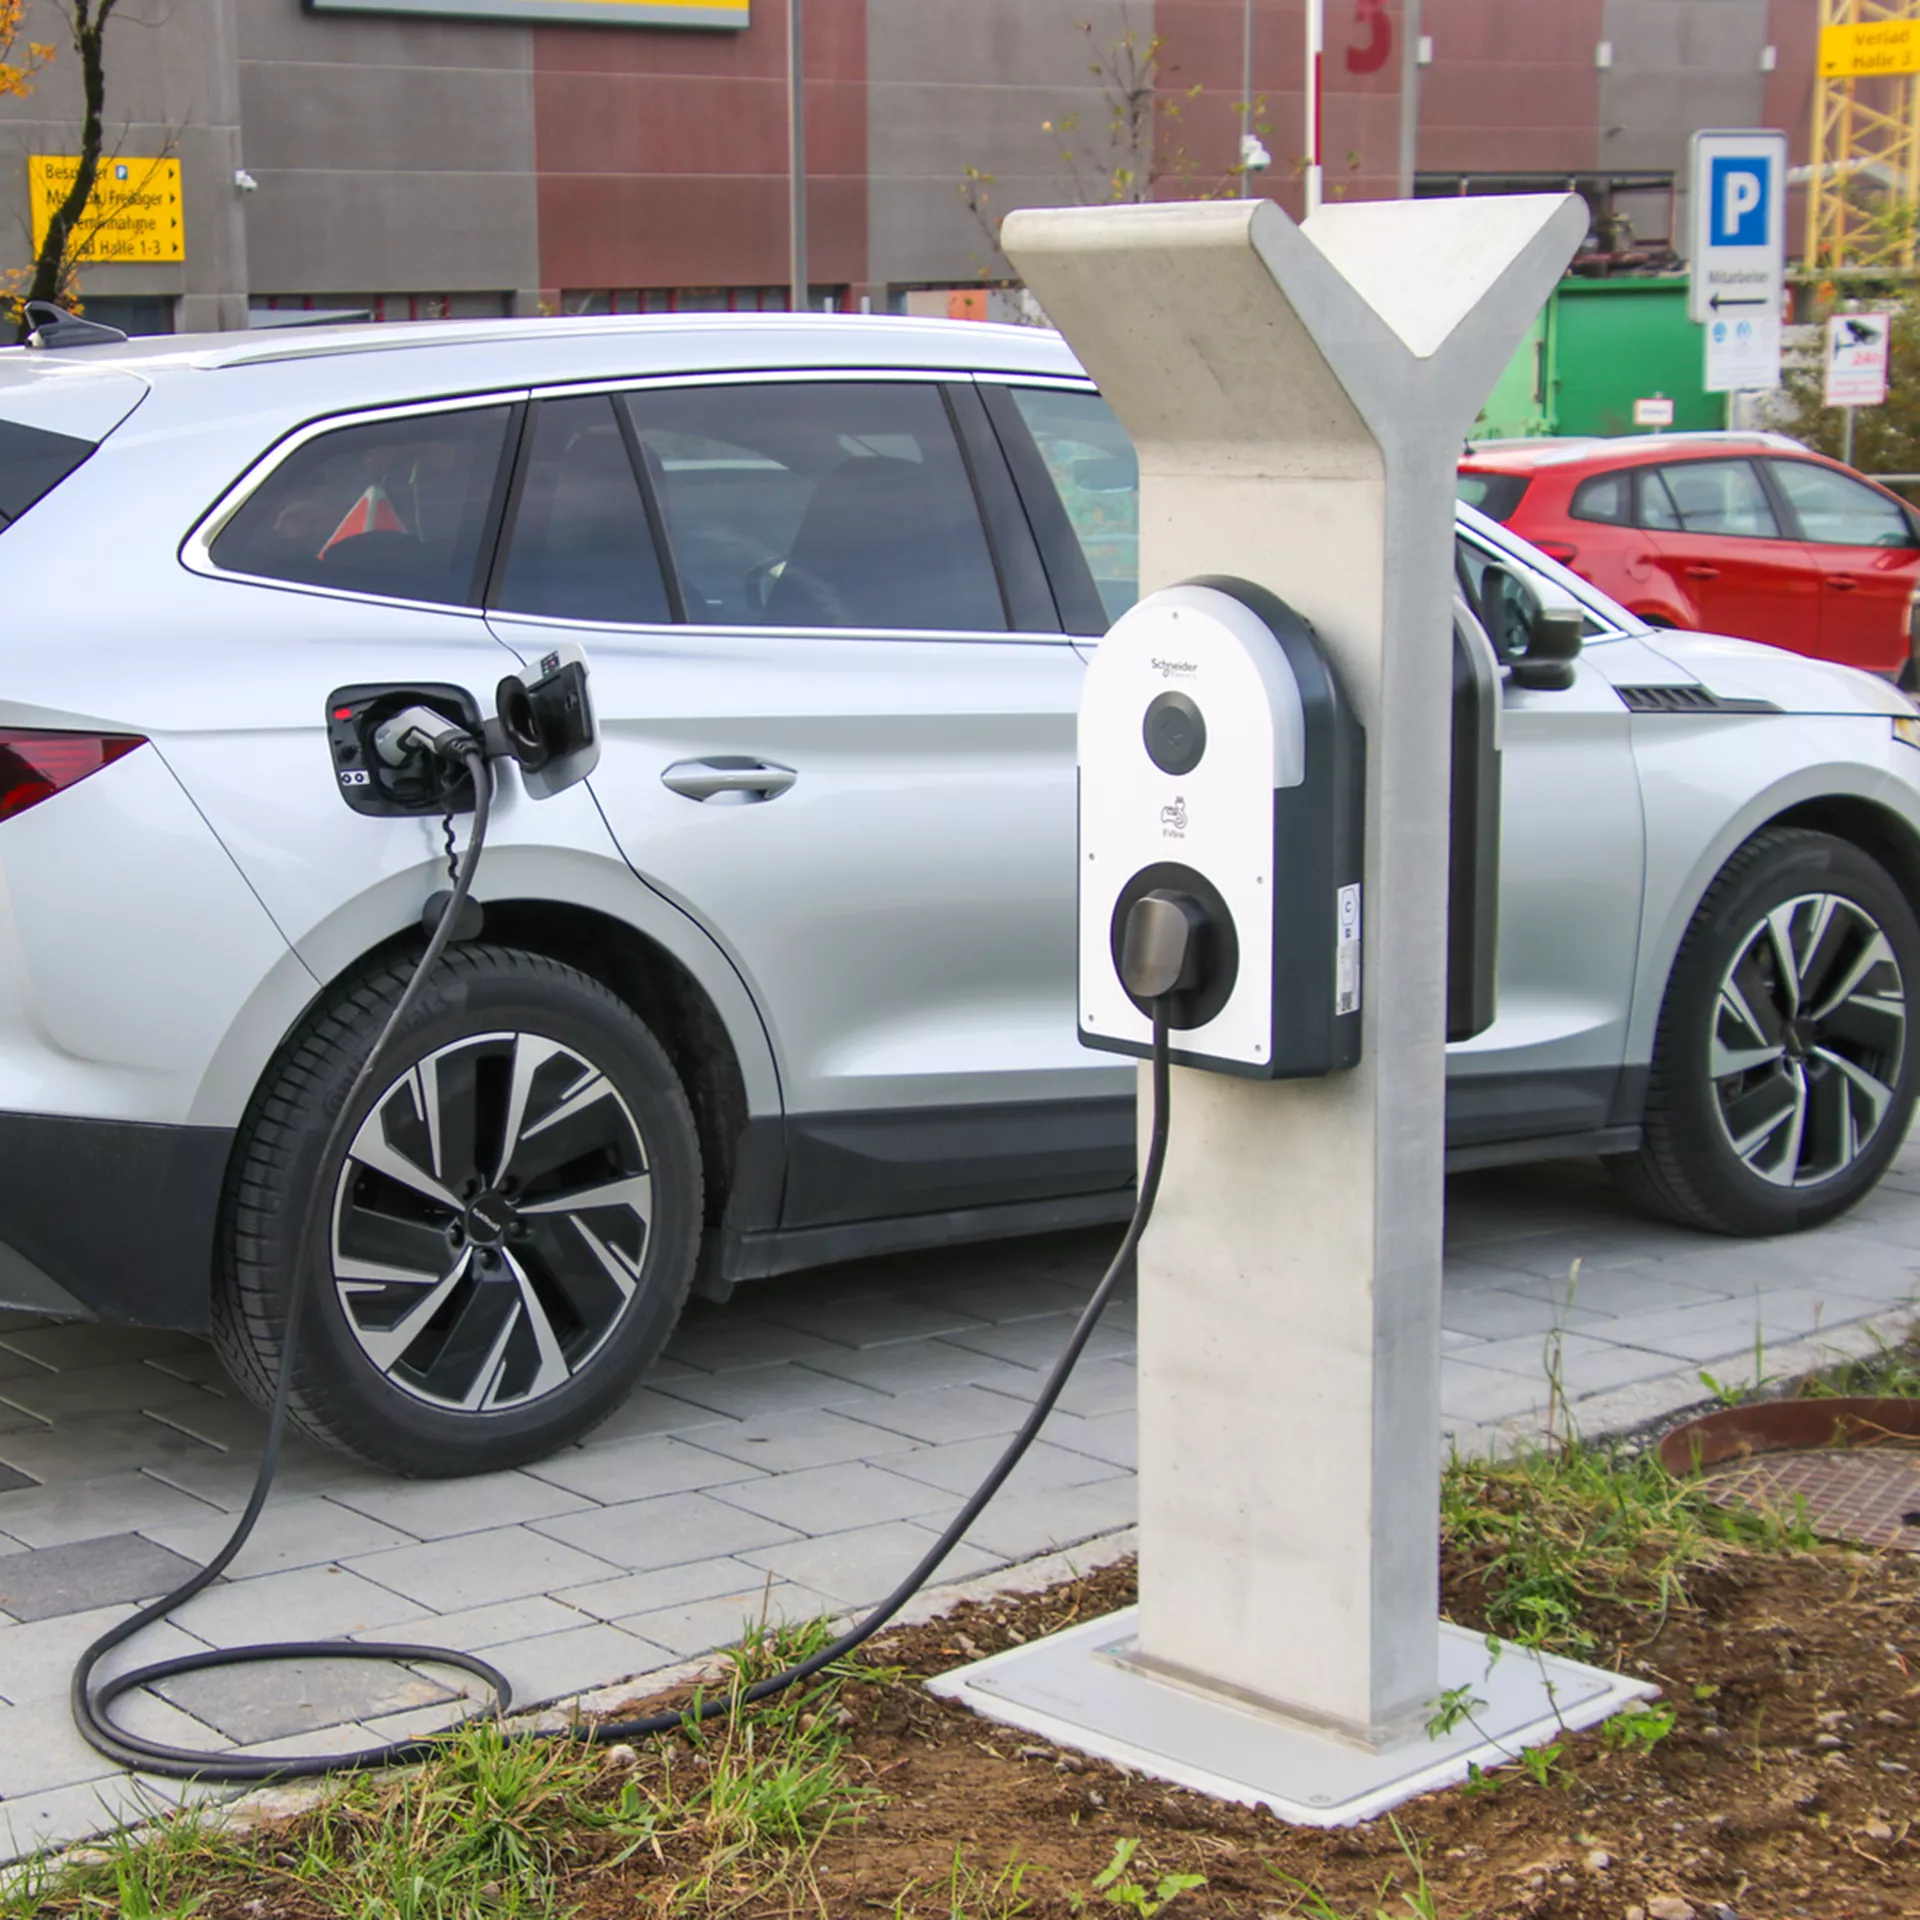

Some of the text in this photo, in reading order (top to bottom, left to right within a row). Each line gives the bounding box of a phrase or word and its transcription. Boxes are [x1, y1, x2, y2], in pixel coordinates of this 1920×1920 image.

[1722, 171, 1760, 234] P
[100, 239, 134, 256] Halle
[140, 239, 161, 256] 1-3
[1151, 657, 1198, 678] Schneider
